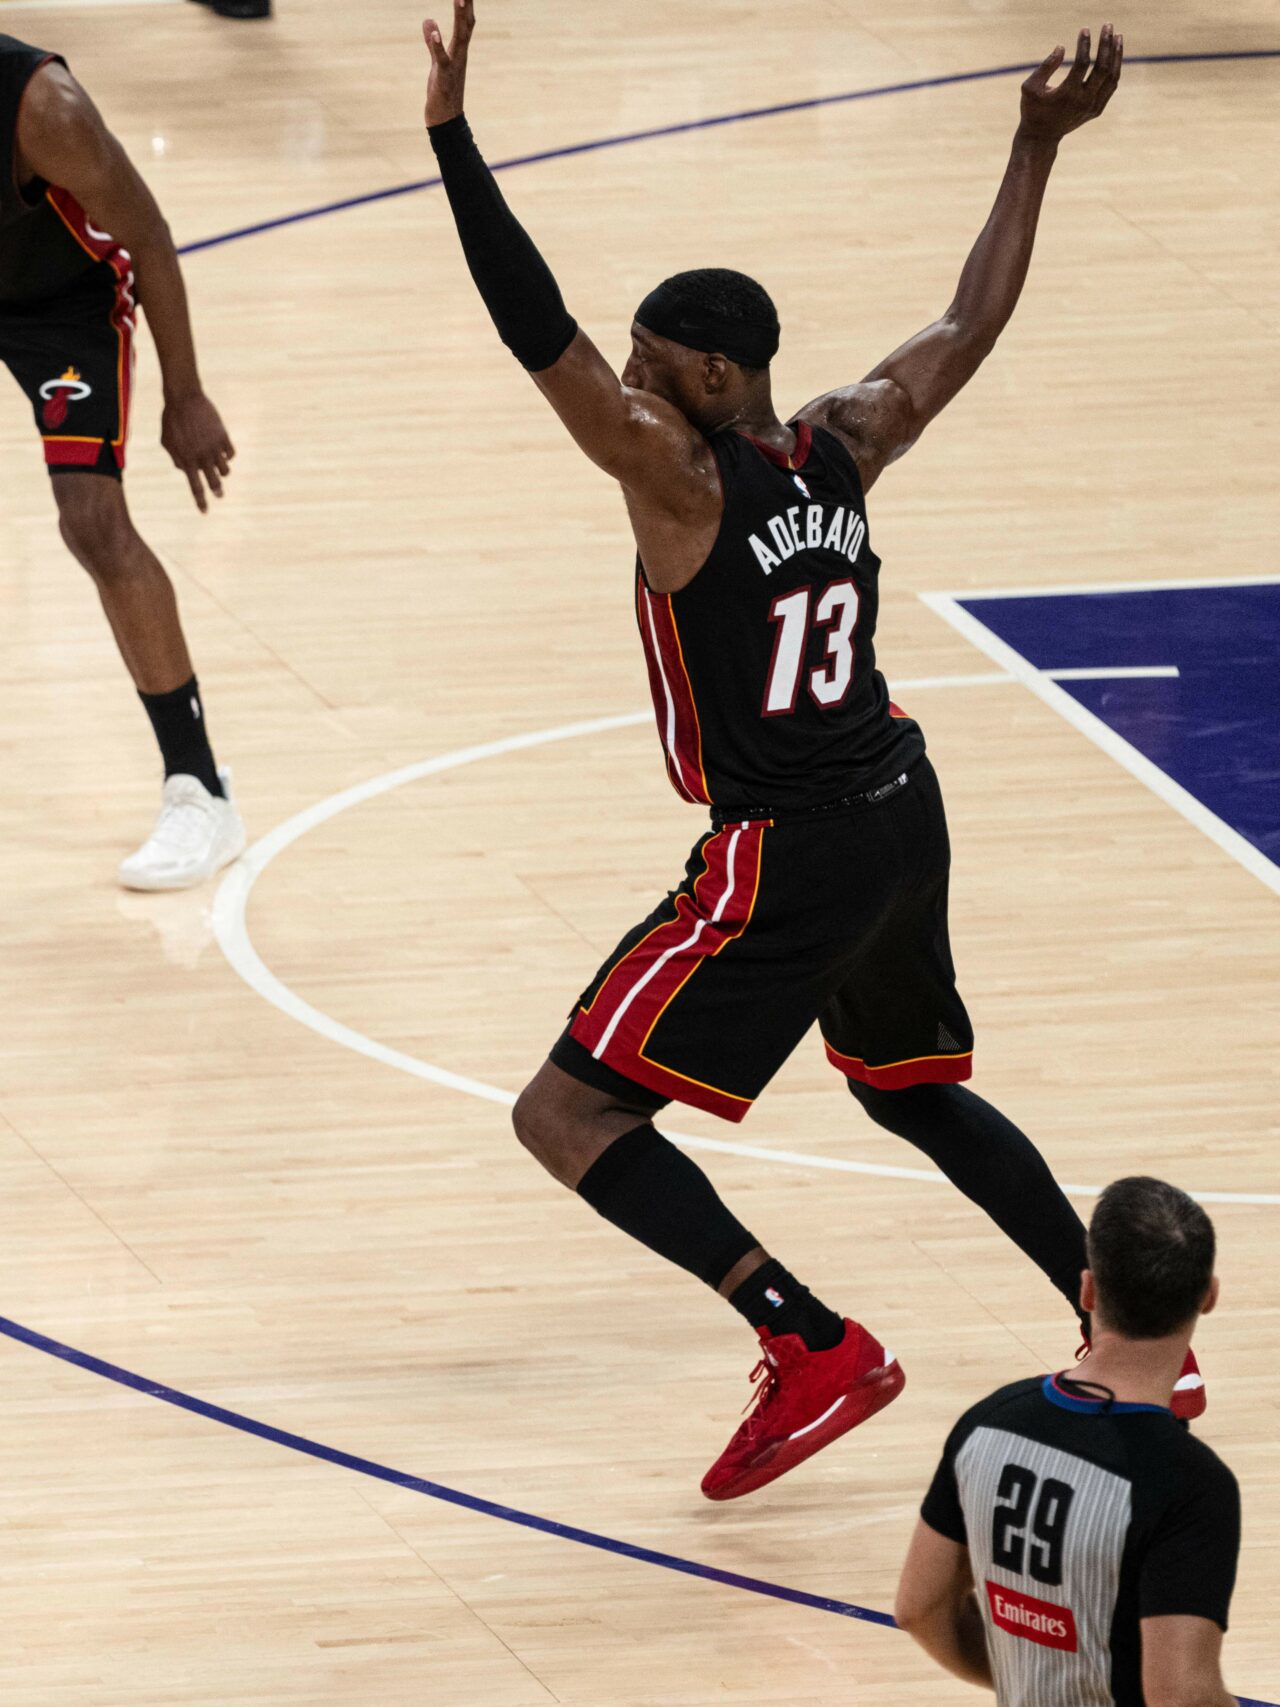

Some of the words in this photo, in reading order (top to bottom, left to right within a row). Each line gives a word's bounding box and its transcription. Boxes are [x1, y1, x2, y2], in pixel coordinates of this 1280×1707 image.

[748, 504, 866, 576] ADEBAYO
[761, 577, 862, 718] 13
[992, 1463, 1075, 1587] 29
[994, 1594, 1068, 1638] Emirates
